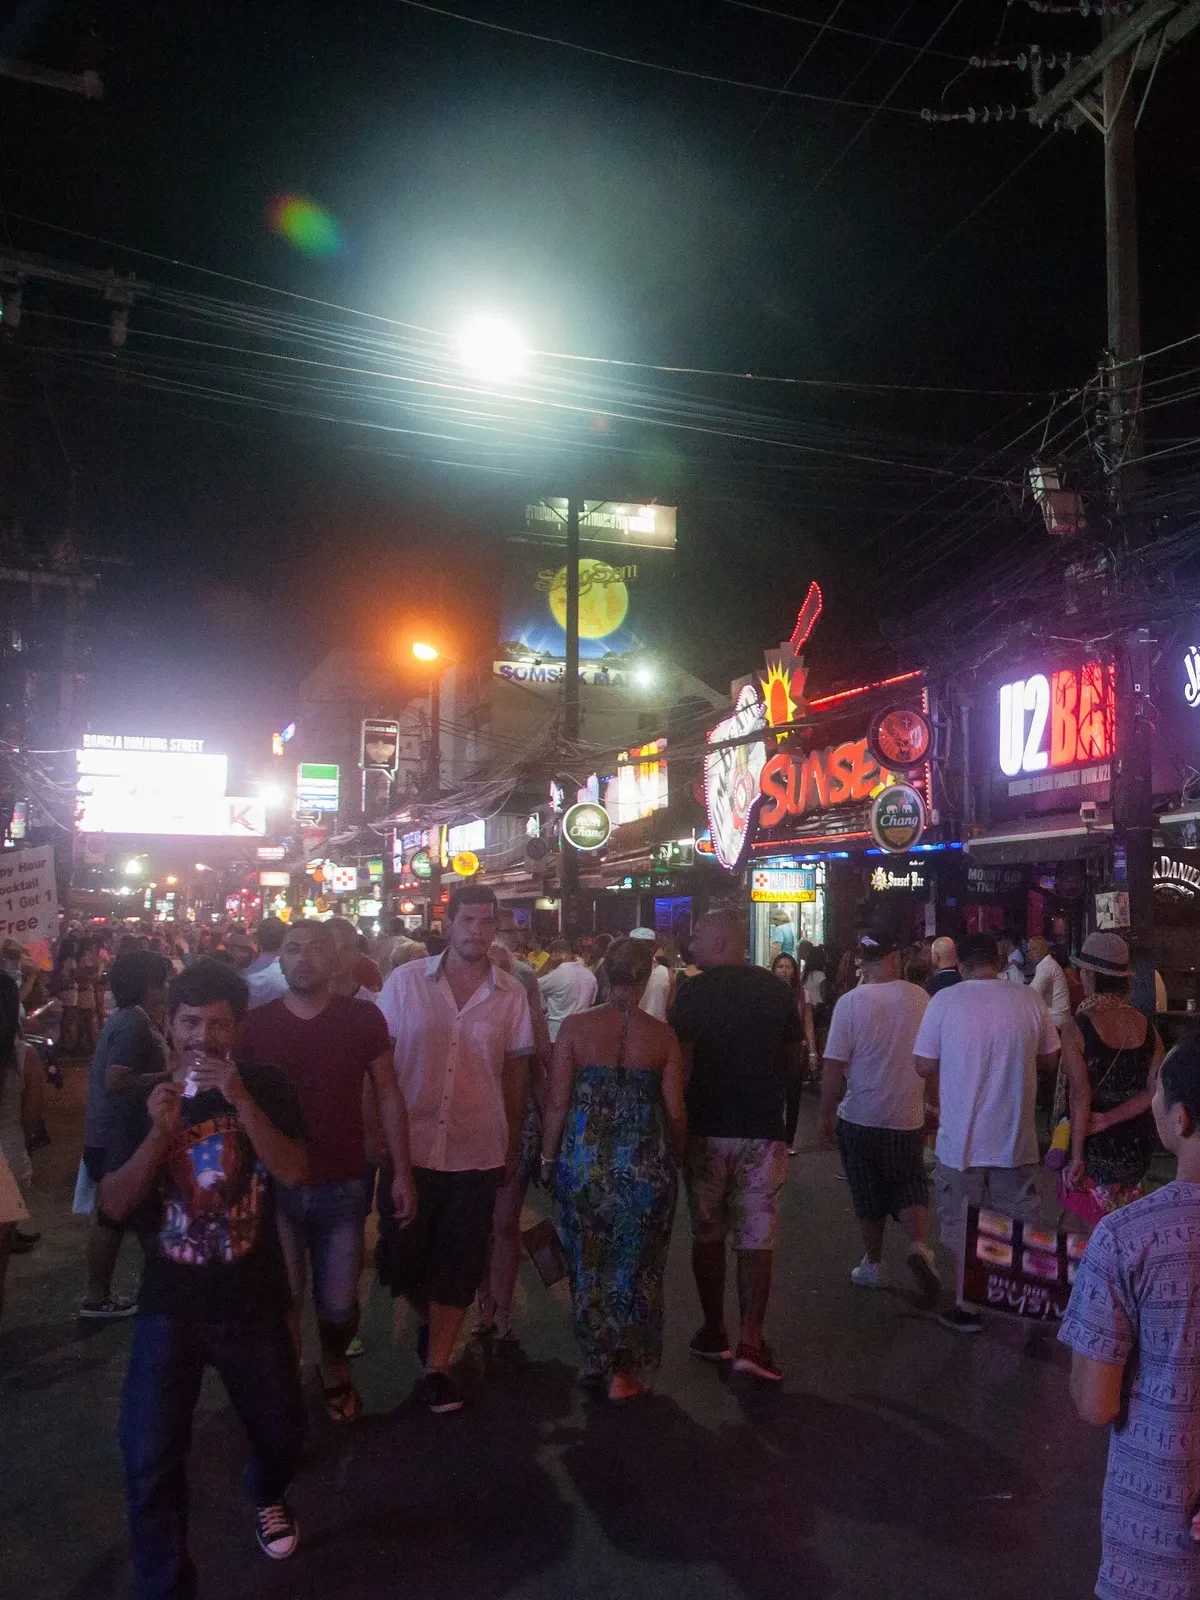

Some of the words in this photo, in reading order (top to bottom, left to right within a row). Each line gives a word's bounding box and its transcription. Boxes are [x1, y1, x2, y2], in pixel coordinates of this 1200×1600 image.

[498, 664, 588, 685] SOMSK
[1000, 673, 1049, 777] U2
[760, 736, 890, 830] SUNSE
[880, 814, 918, 828] Chang
[18, 860, 46, 872] Hour
[20, 894, 39, 909] Get
[753, 890, 813, 900] PHARMACY
